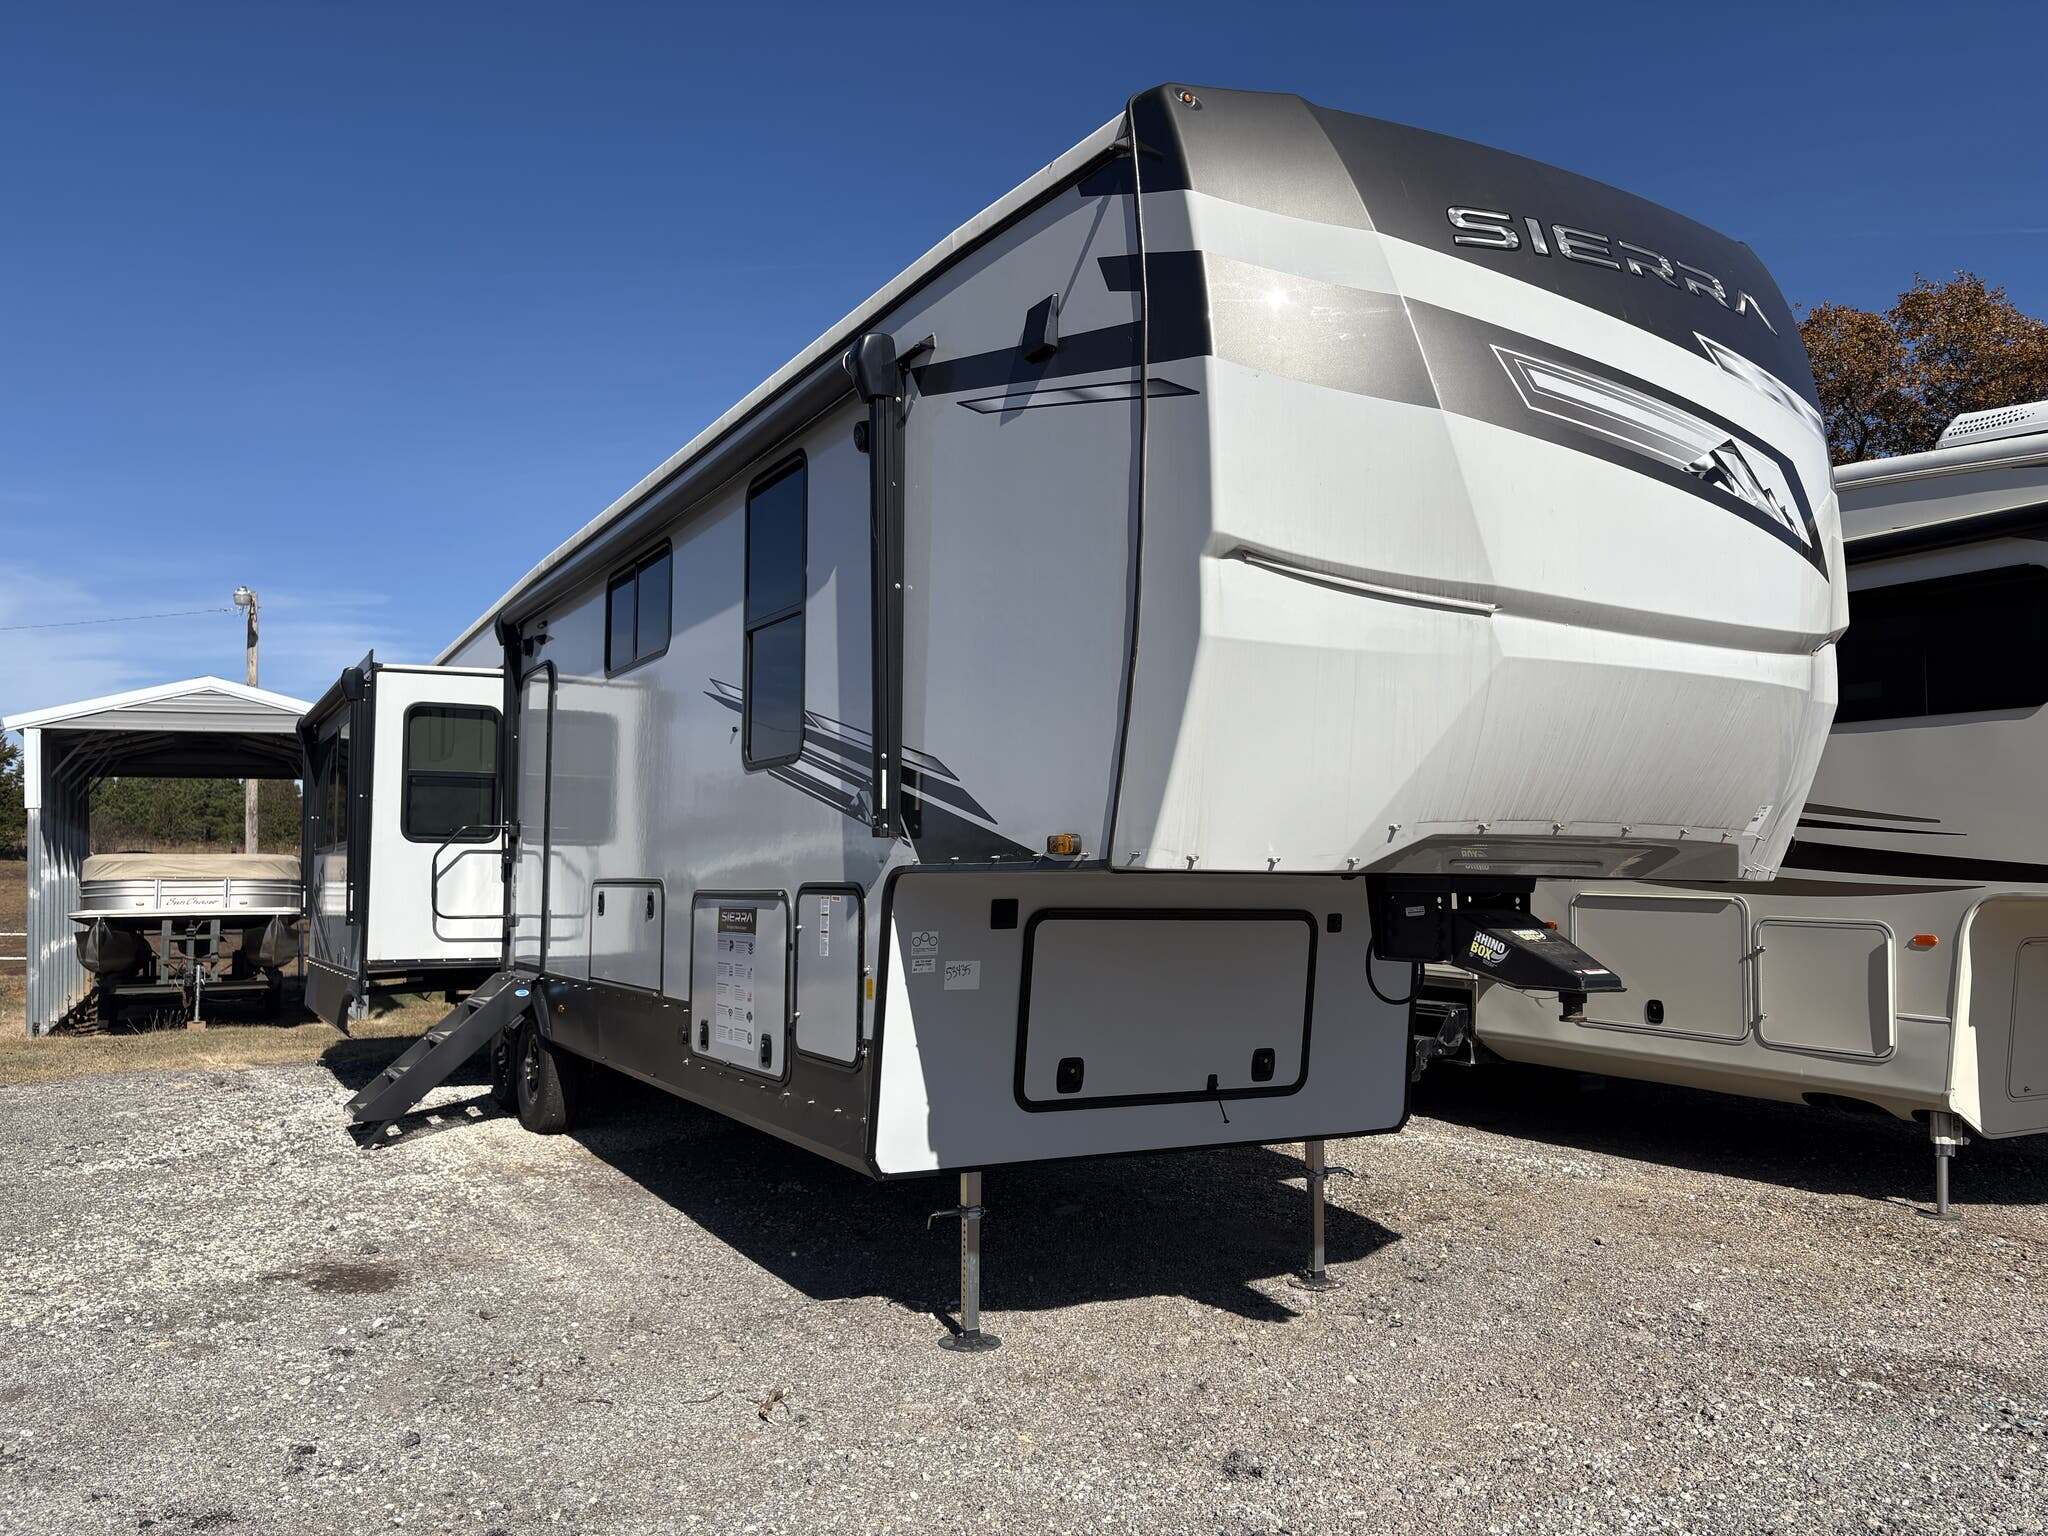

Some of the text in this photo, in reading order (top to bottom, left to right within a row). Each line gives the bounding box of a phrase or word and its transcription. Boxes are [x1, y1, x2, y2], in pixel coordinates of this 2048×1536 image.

[1447, 206, 1778, 336] SIERRA
[721, 911, 753, 923] SIERRA
[1470, 940, 1493, 961] BOX
[1474, 930, 1505, 954] RHINO
